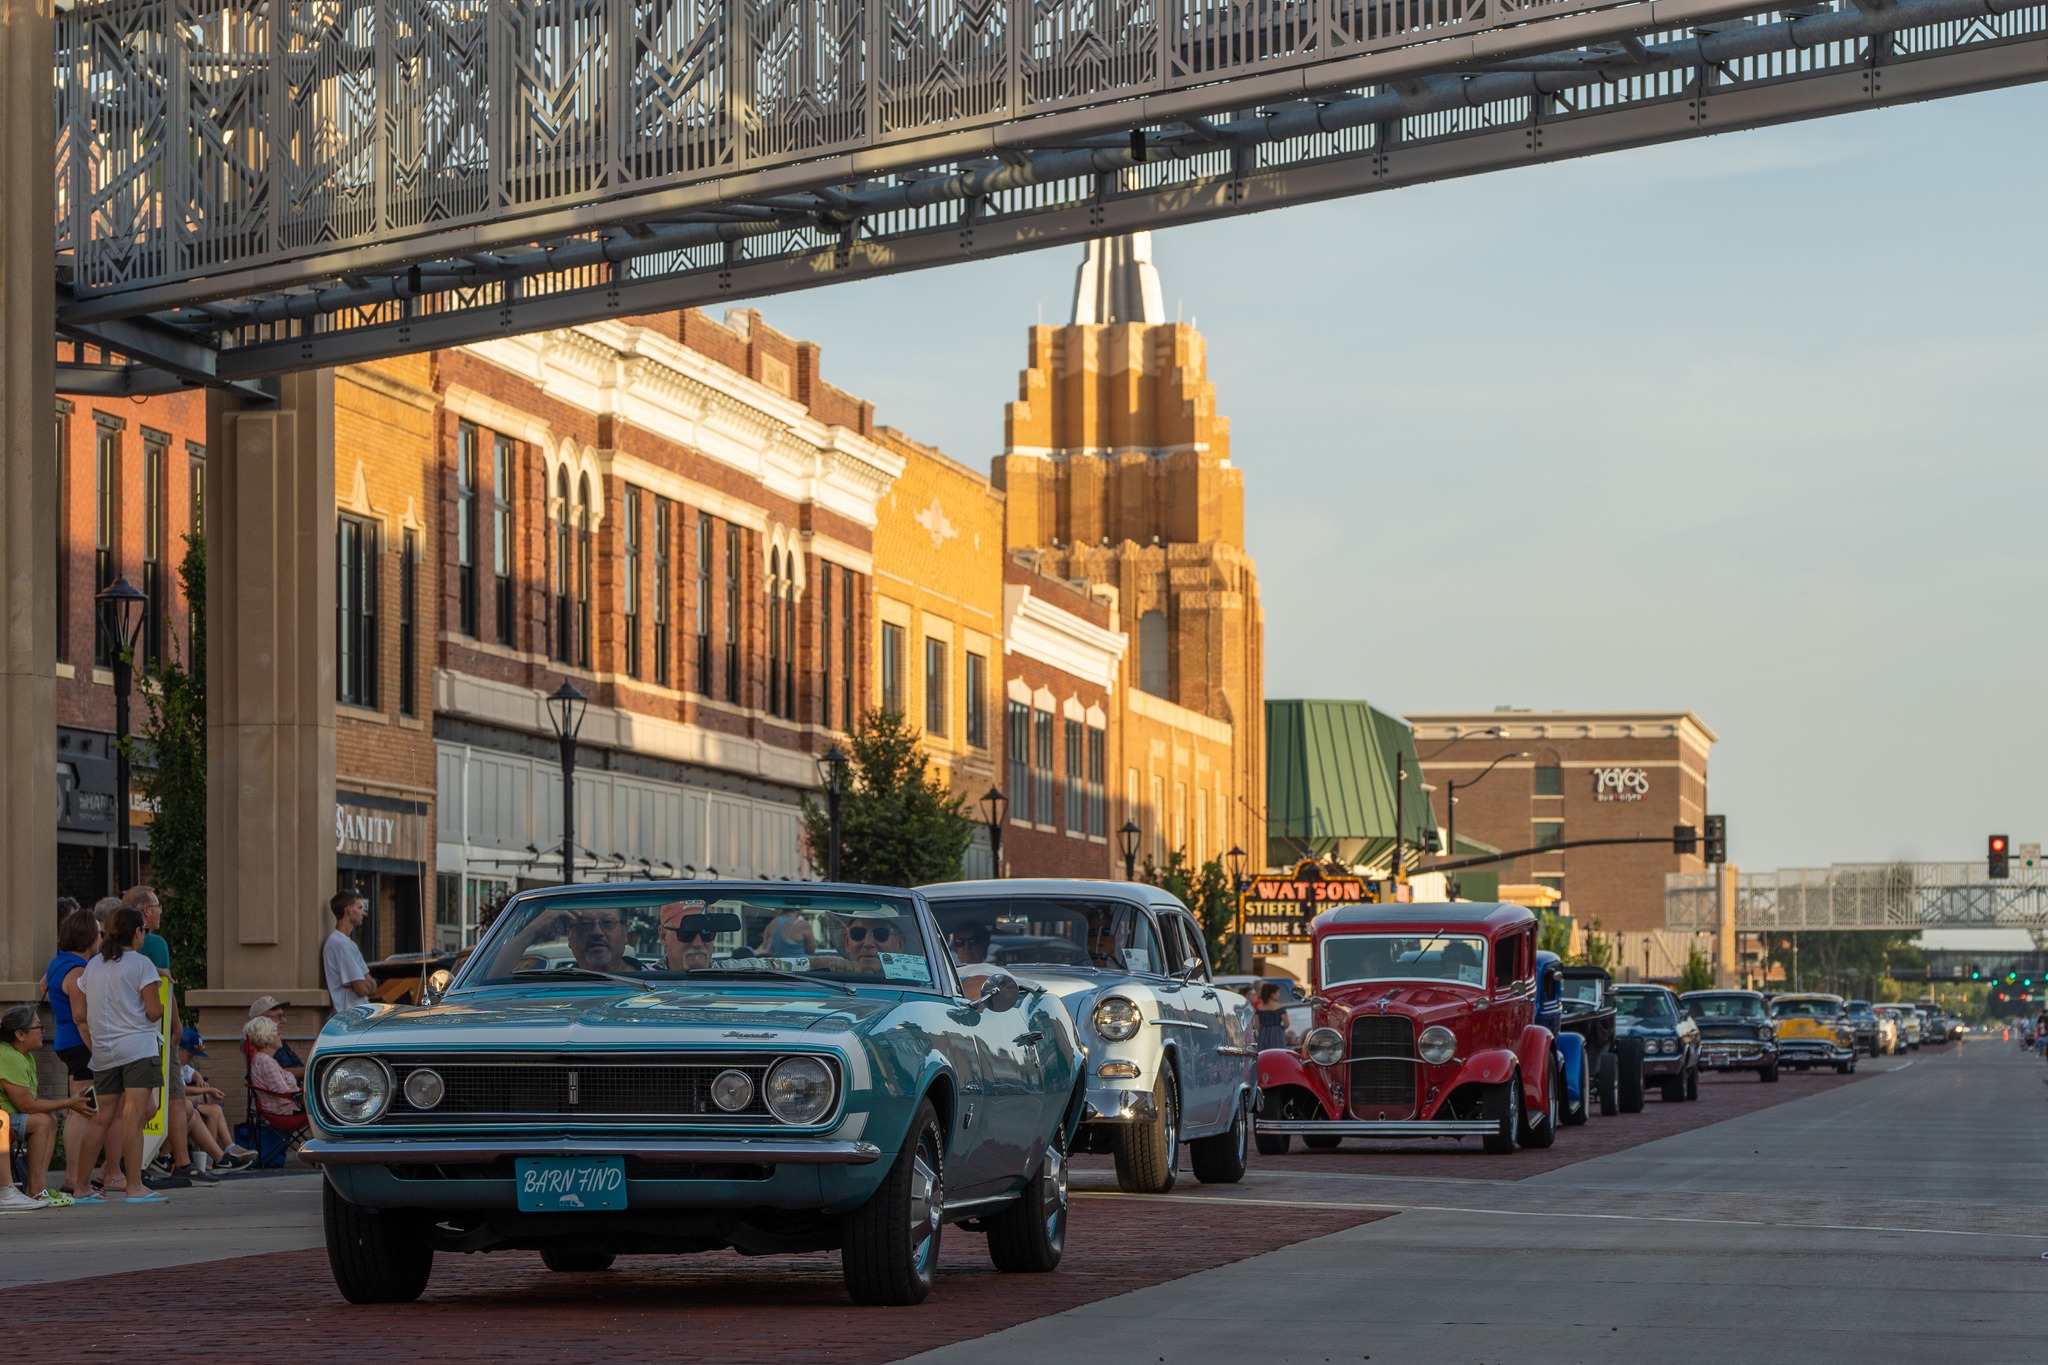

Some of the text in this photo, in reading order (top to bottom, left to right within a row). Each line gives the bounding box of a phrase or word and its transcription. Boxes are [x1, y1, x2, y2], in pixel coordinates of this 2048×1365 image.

[336, 803, 394, 851] SANITY
[1258, 882, 1360, 900] WATSON
[1245, 902, 1304, 916] STIEFEL
[1245, 922, 1289, 935] MADDIE
[524, 1167, 622, 1193] BARN FIND
